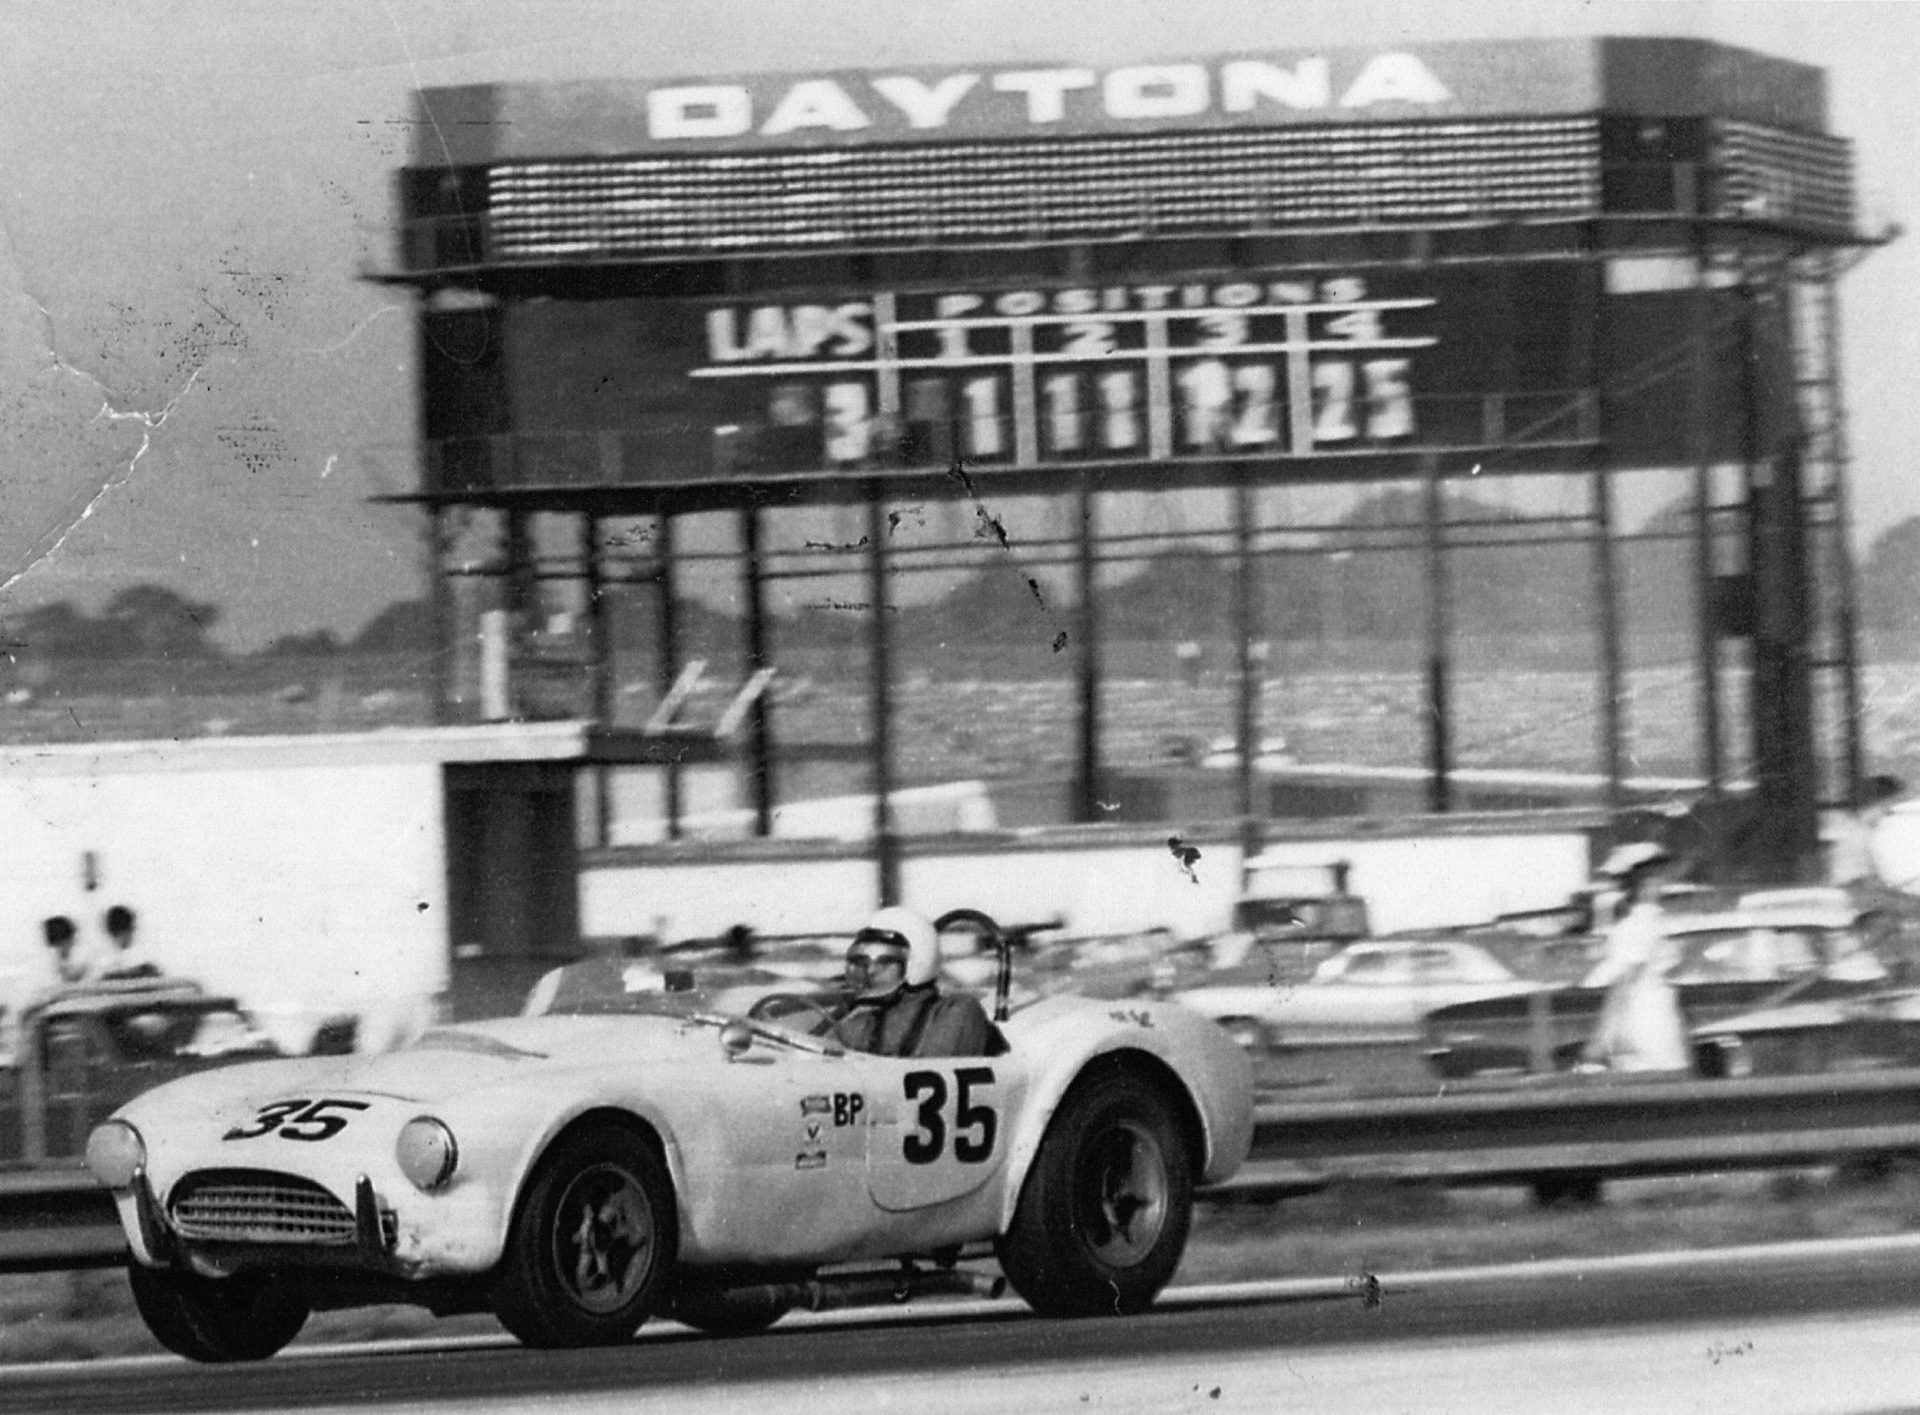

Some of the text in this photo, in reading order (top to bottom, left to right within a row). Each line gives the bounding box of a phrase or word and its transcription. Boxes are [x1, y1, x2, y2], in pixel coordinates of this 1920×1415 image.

[646, 51, 1452, 139] DAYTONA
[936, 277, 1367, 318] POSITIONS
[706, 302, 872, 361] LAPS
[1064, 321, 1118, 354] 2
[1200, 312, 1250, 347] 3
[1324, 308, 1382, 342] 4
[222, 1098, 372, 1141] 35
[833, 1092, 864, 1127] BP
[903, 1066, 997, 1165] 35
